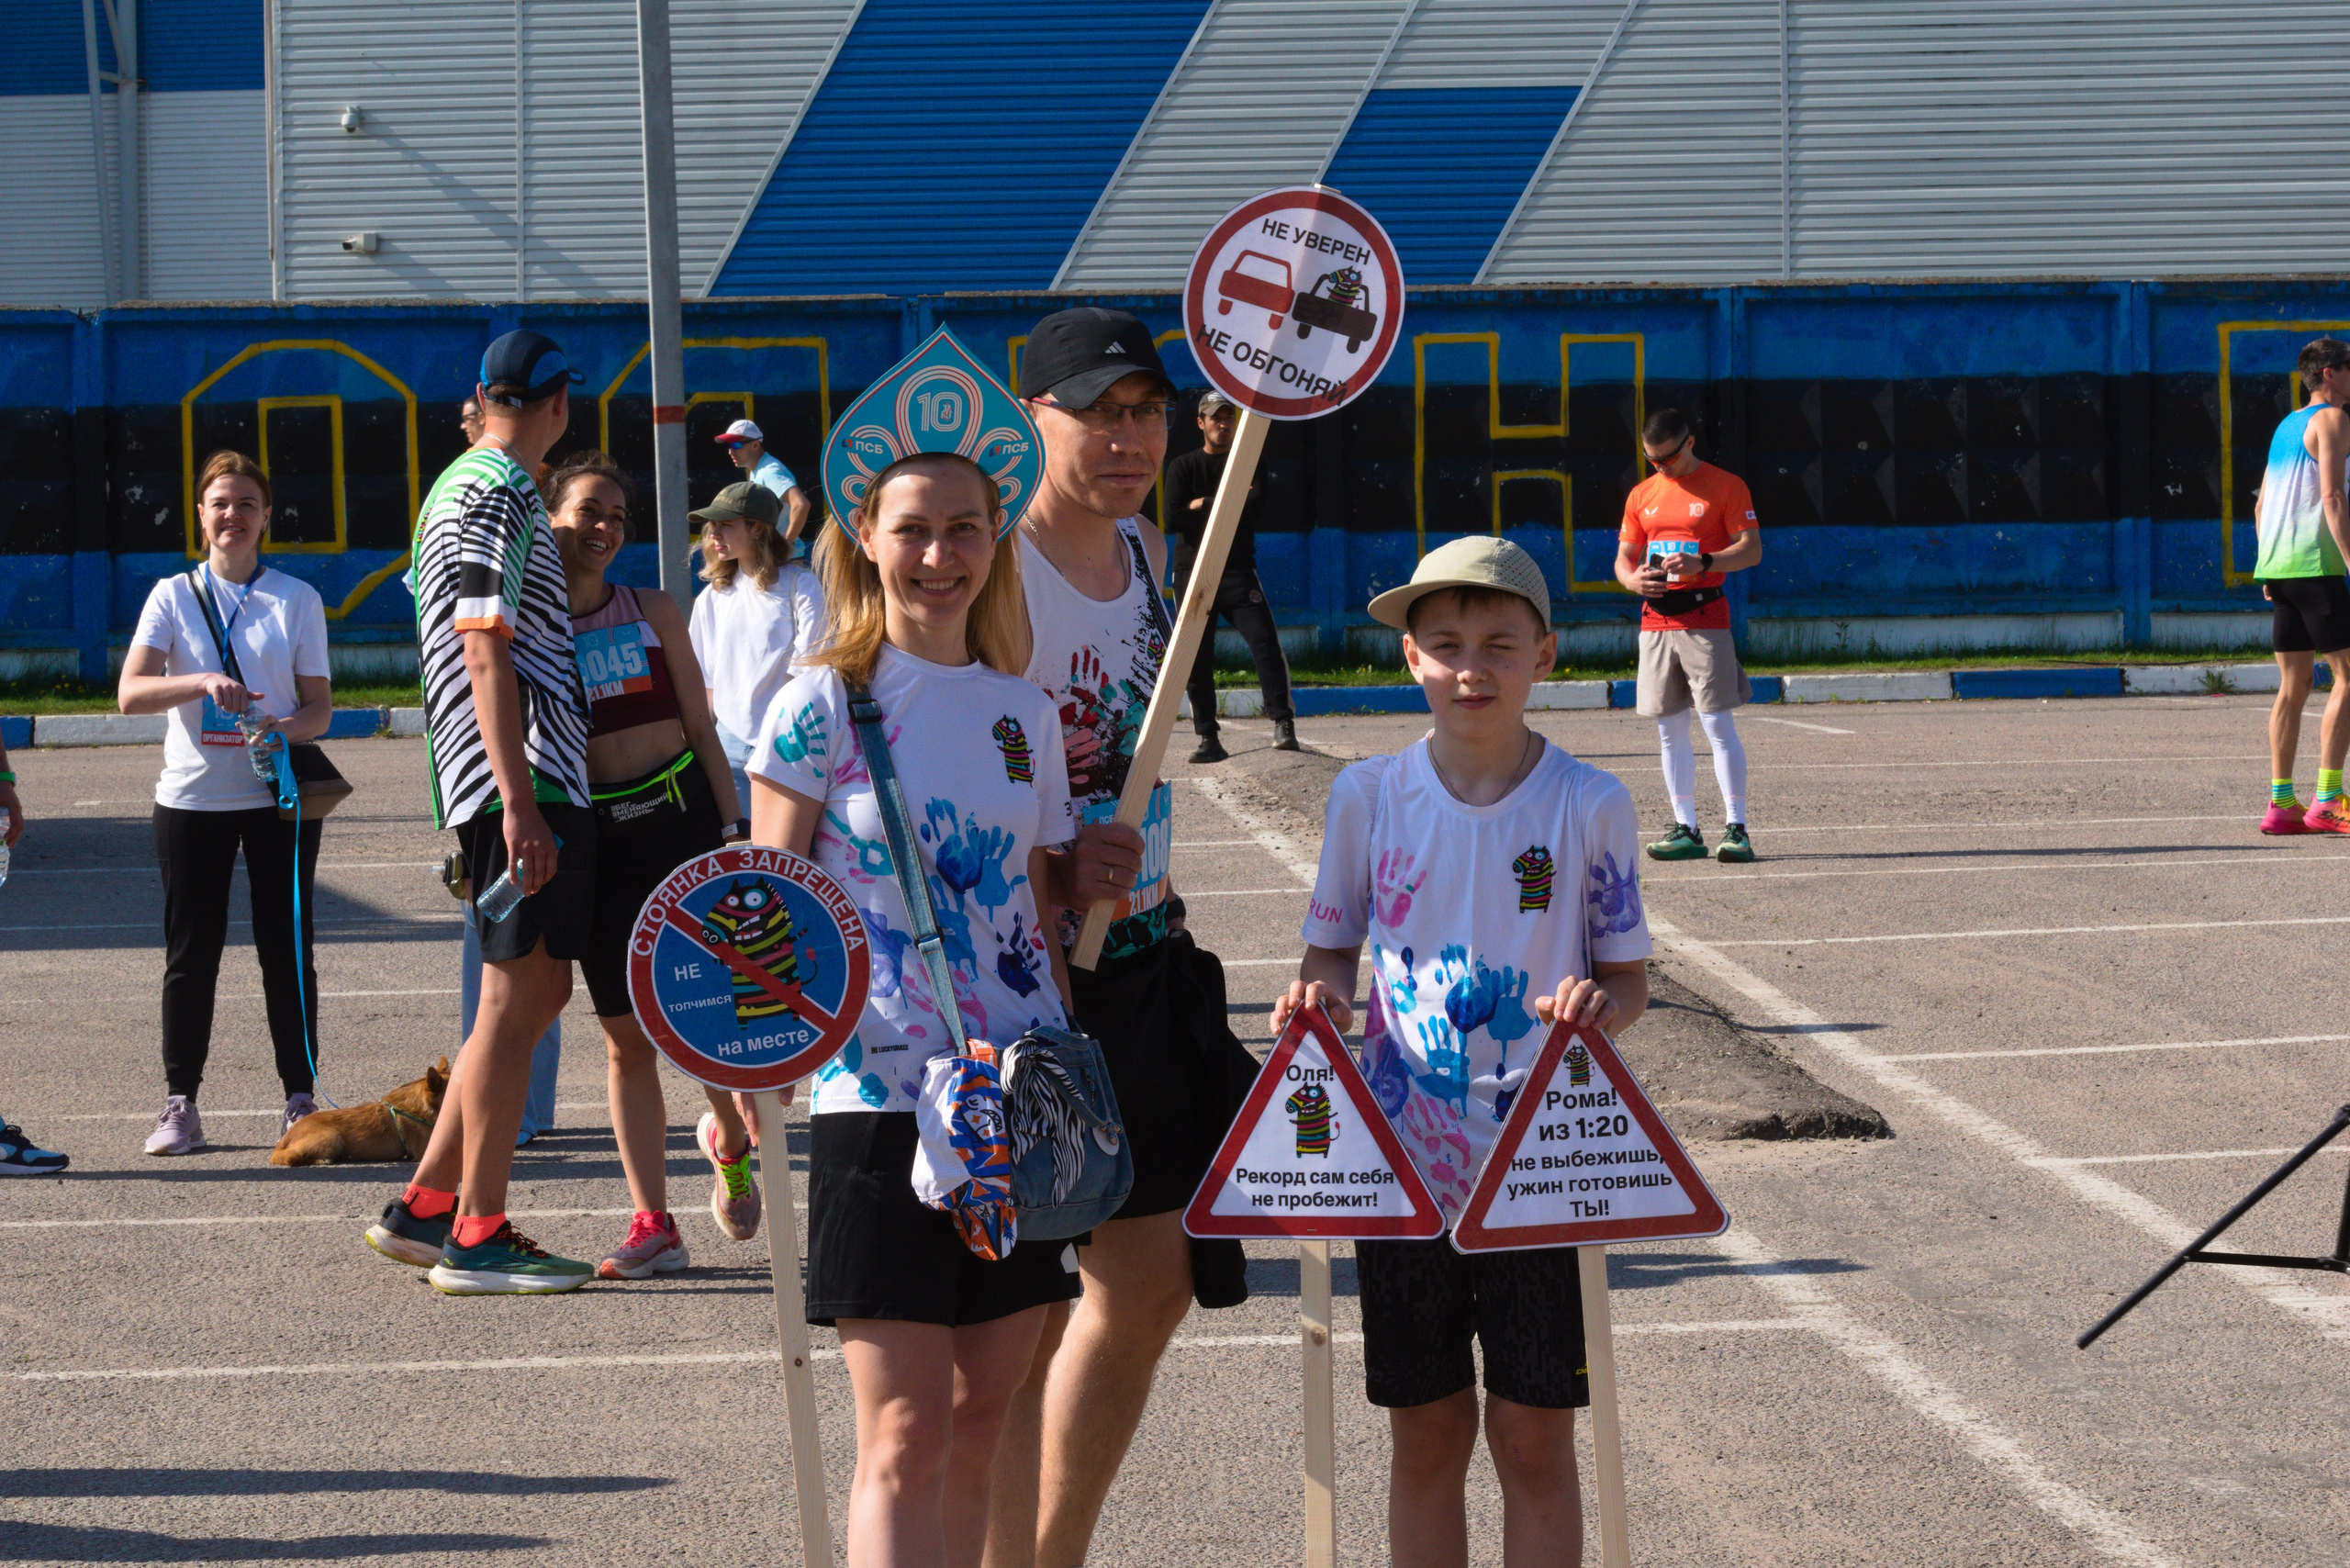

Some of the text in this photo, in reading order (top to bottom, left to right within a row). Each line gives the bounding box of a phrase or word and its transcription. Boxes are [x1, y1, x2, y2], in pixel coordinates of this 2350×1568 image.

[1261, 218, 1371, 265] НЕ УВЕРЕН
[1195, 324, 1348, 407] НЕ ОБГОНЯЙ
[916, 391, 962, 432] 10
[855, 441, 884, 454] ПСБ
[1002, 442, 1029, 455] ПСБ
[1689, 503, 1705, 517] 10
[202, 733, 243, 745] ОРГАНИЗАТОР
[632, 850, 865, 957] СТОЯНКА ЗАПРЕЩЕНА
[1128, 882, 1158, 916] 21.1KM
[1310, 897, 1343, 924] RUN
[674, 963, 701, 981] НЕ
[668, 994, 732, 1013] топчимся
[717, 1029, 810, 1057] на месте
[1286, 1064, 1335, 1082] Оля!
[1546, 1087, 1617, 1111] Рома!
[1539, 1114, 1628, 1142] из 1:20
[1511, 1148, 1665, 1171] не выбежишь,
[1236, 1168, 1394, 1187] Рекорд сам себя
[1506, 1172, 1673, 1201] ужин готовишь
[1251, 1192, 1378, 1210] не пробежит!
[1569, 1199, 1610, 1218] ТЫ!
